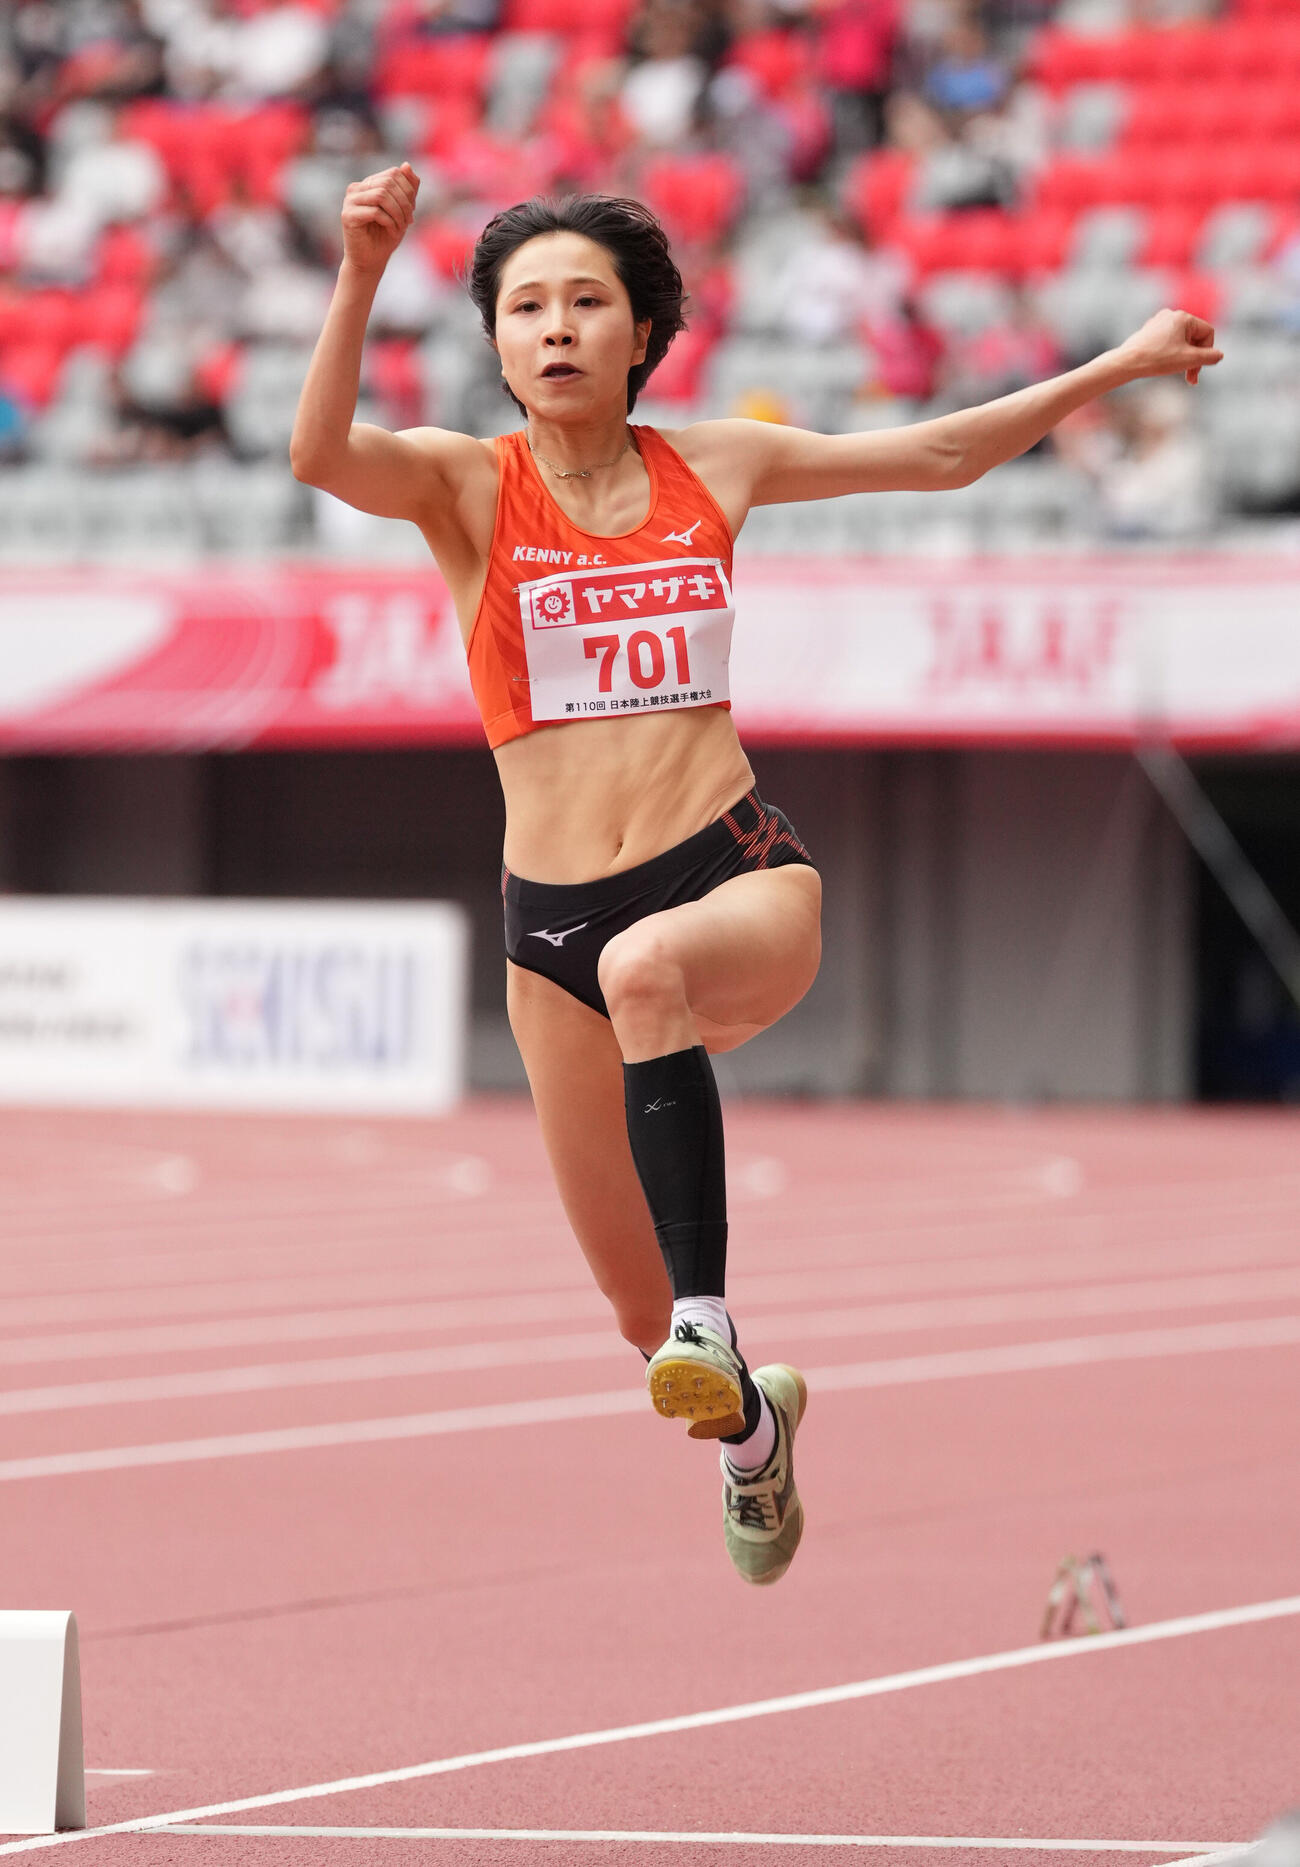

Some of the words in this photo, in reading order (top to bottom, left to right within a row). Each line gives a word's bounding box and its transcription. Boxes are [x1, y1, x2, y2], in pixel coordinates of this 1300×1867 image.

[512, 546, 573, 565] KENNY
[577, 554, 607, 566] a.c.
[582, 574, 716, 613] ヤマザキ
[582, 626, 691, 693] 701
[565, 700, 606, 713] 第110回
